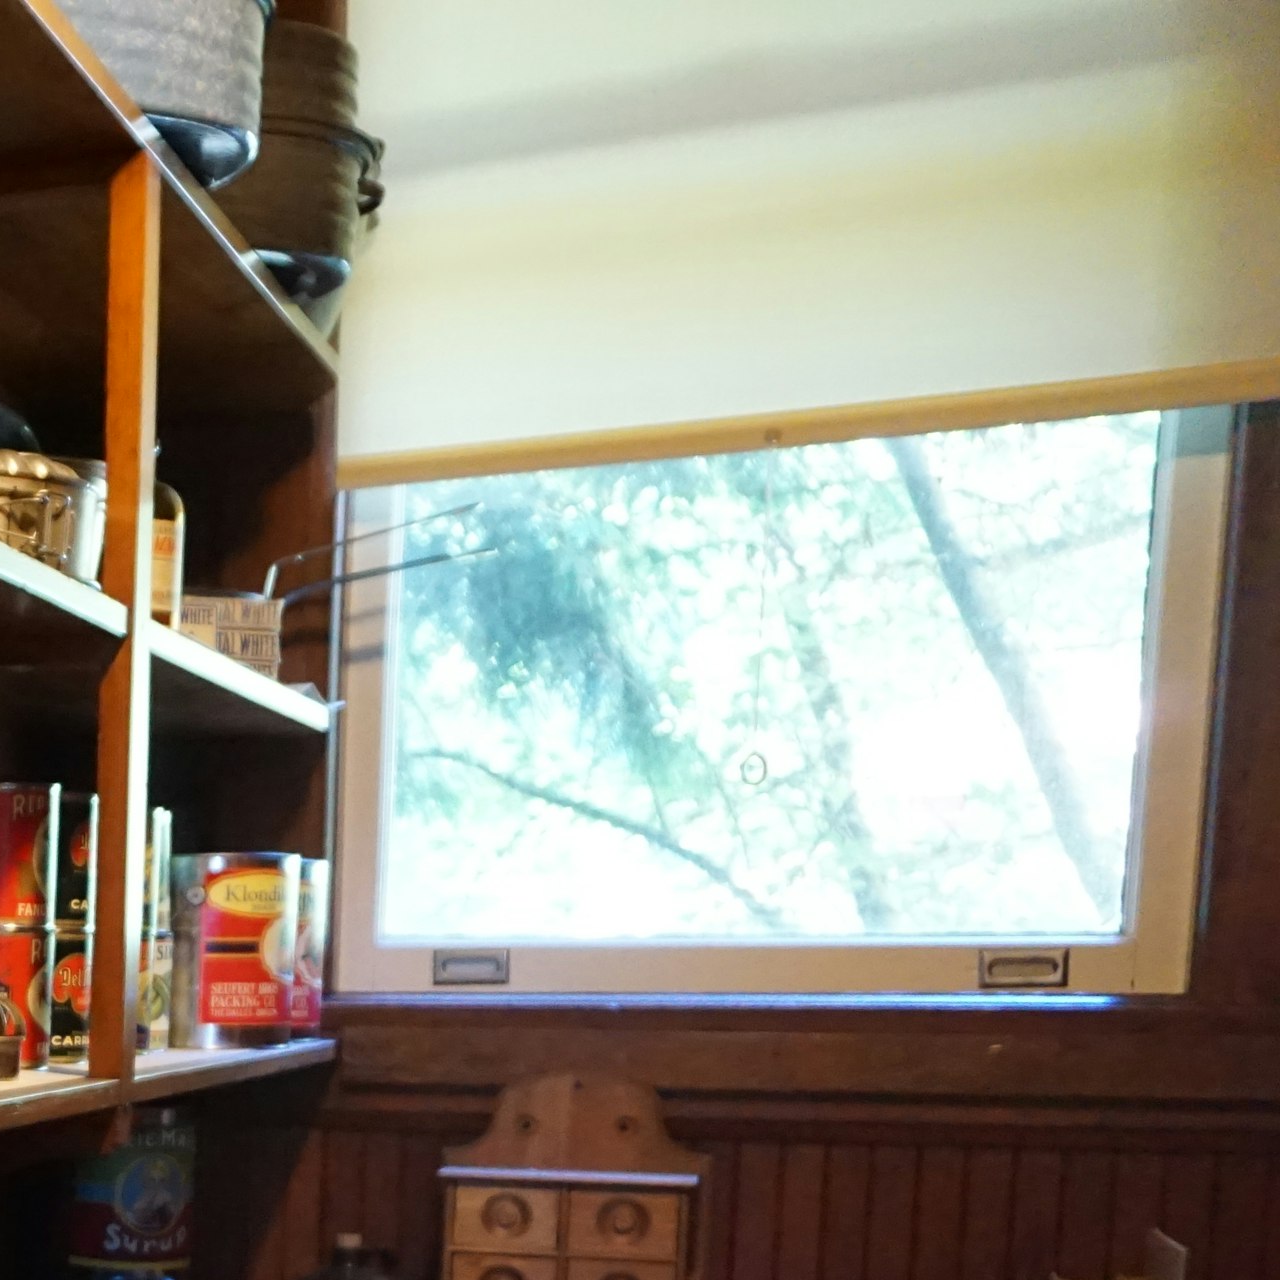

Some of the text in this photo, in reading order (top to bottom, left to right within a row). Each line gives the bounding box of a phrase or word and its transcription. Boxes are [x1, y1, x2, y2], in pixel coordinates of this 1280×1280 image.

[181, 608, 214, 625] WHITE
[241, 634, 277, 656] WHITE
[211, 994, 260, 1008] PACKING
